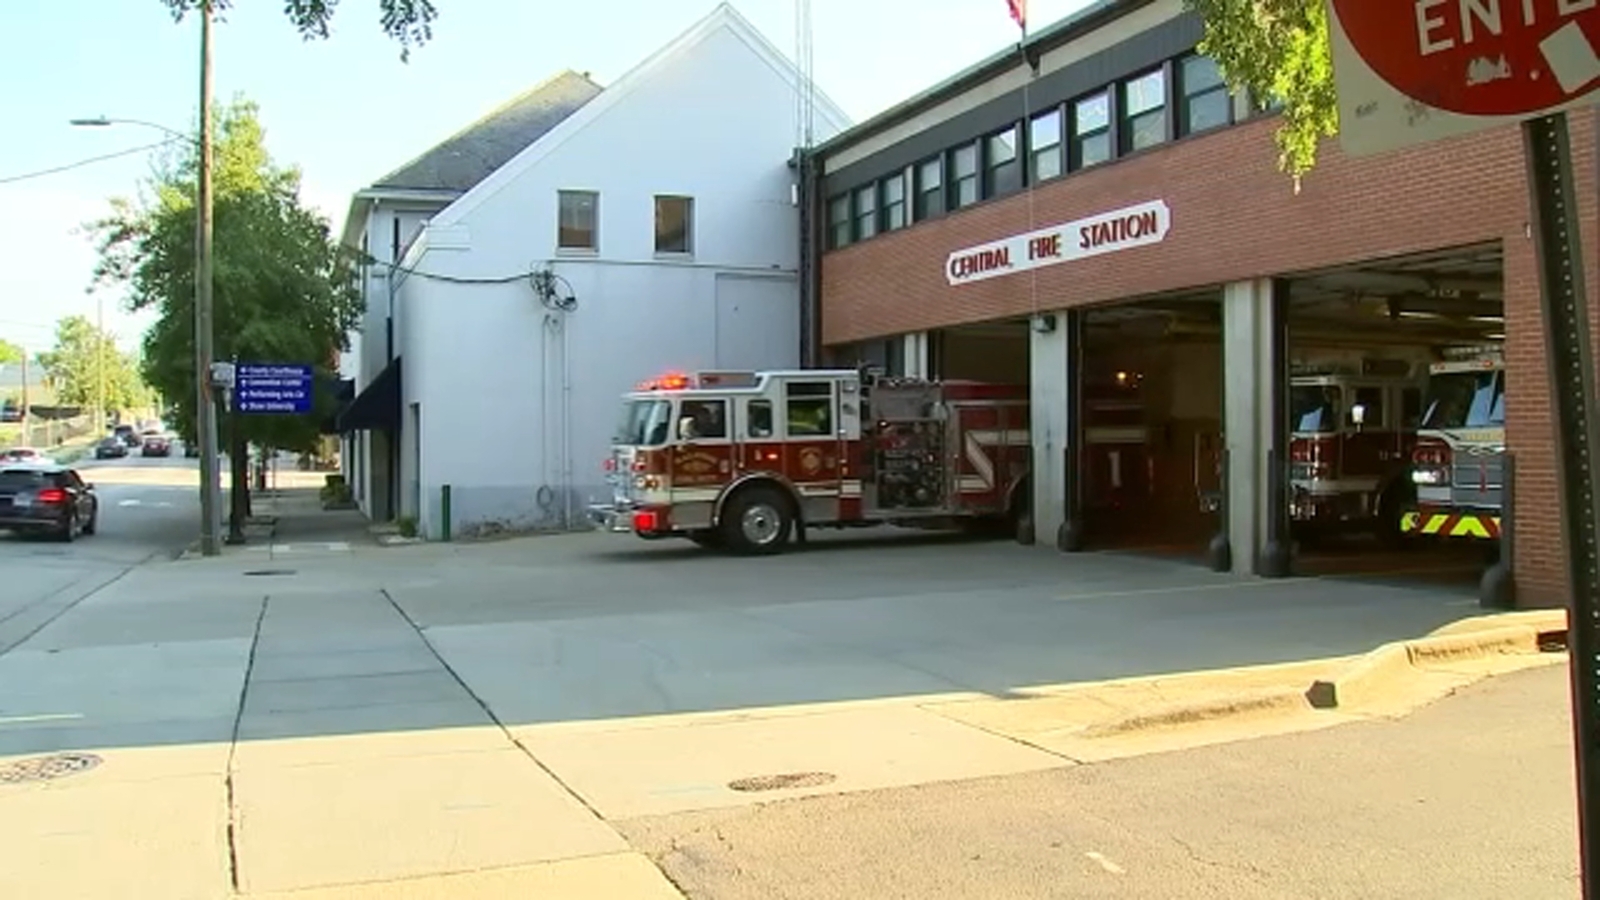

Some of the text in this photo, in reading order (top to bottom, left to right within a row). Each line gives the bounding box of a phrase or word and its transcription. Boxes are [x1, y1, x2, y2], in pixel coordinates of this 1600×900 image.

[1415, 0, 1598, 56] ENT
[950, 210, 1157, 278] CENTRAL FIRE STATION
